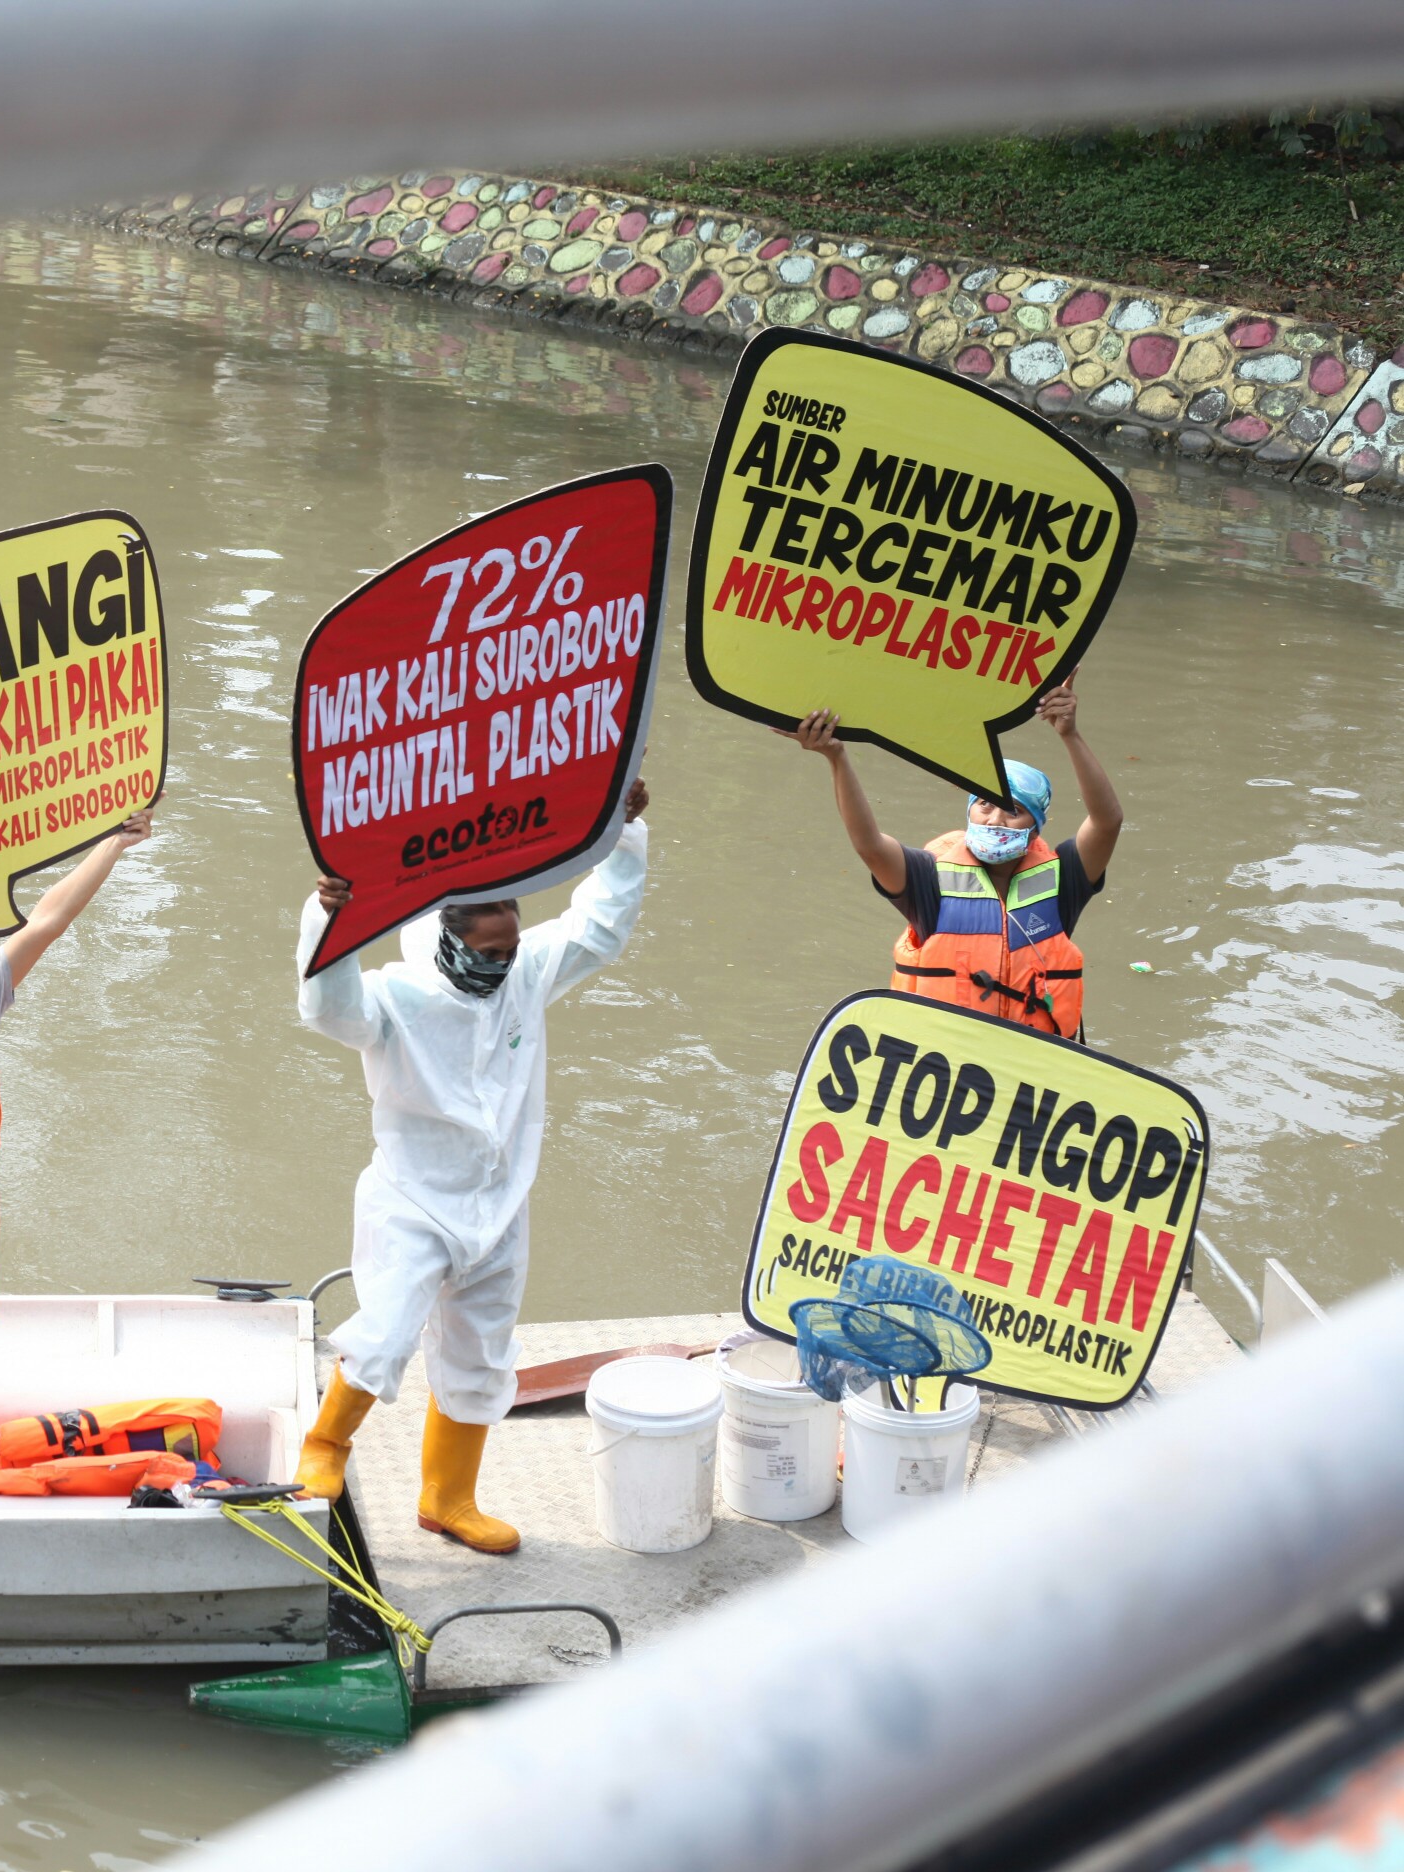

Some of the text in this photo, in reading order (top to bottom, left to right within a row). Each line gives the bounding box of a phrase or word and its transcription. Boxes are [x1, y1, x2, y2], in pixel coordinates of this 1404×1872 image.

[762, 389, 847, 434] SUMBER
[420, 525, 584, 645] 72%
[738, 484, 1082, 629] TERCEMAR
[474, 592, 645, 702] SUROBOYO
[45, 768, 154, 833] SUROBOYO
[320, 719, 474, 838] NGUNTAL
[401, 796, 549, 868] ecoton
[817, 1023, 997, 1150] STOP
[786, 1121, 1177, 1333] SACHETAN
